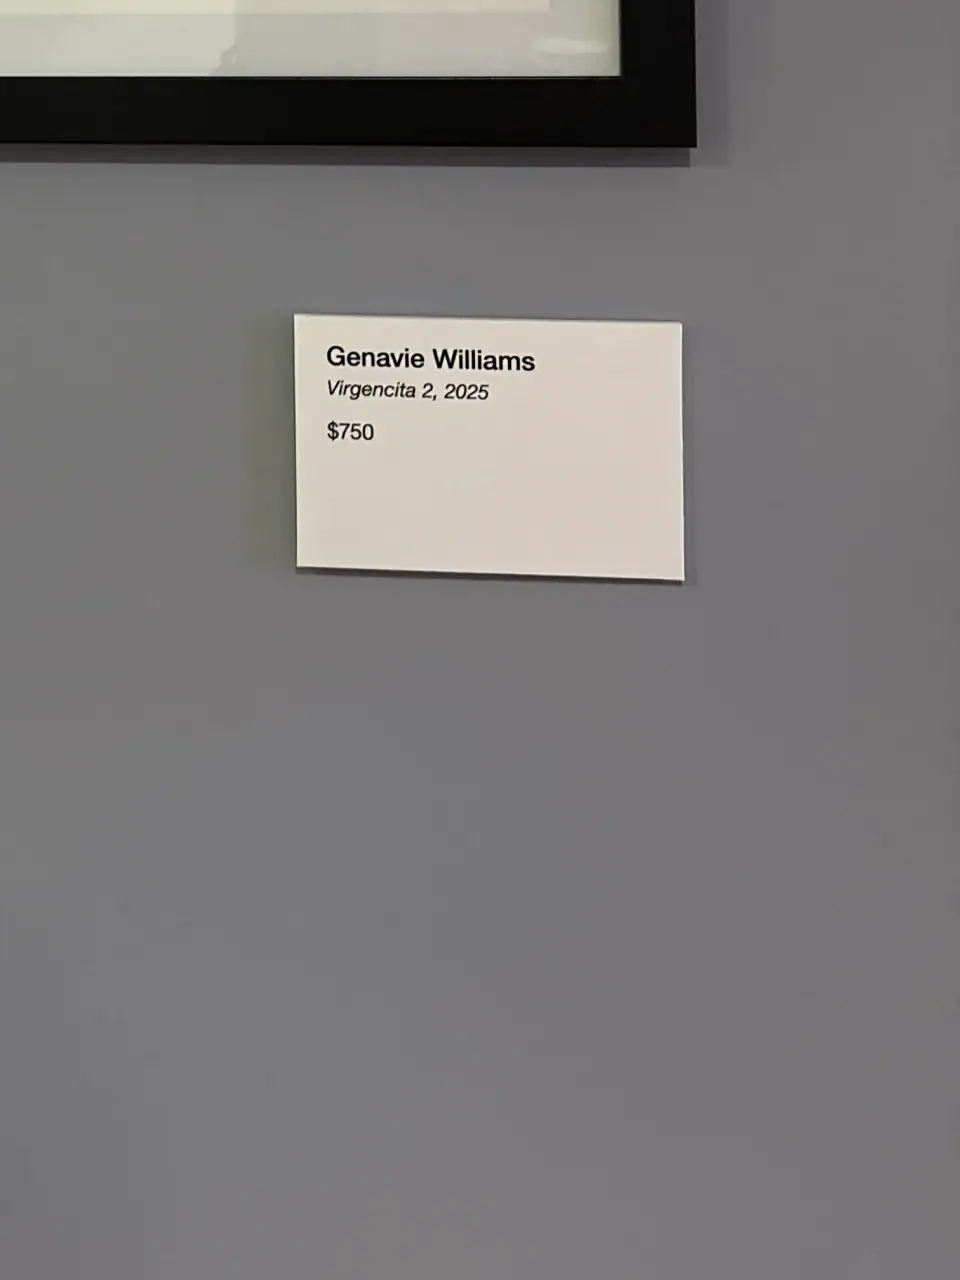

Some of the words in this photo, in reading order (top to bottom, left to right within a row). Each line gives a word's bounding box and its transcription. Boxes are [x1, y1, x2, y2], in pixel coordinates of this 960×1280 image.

[326, 345, 425, 369] Genavie
[432, 348, 536, 372] Williams
[327, 380, 416, 400] Virgencita
[421, 382, 438, 402] 2,
[444, 383, 490, 401] 2025
[327, 420, 375, 442] $750
